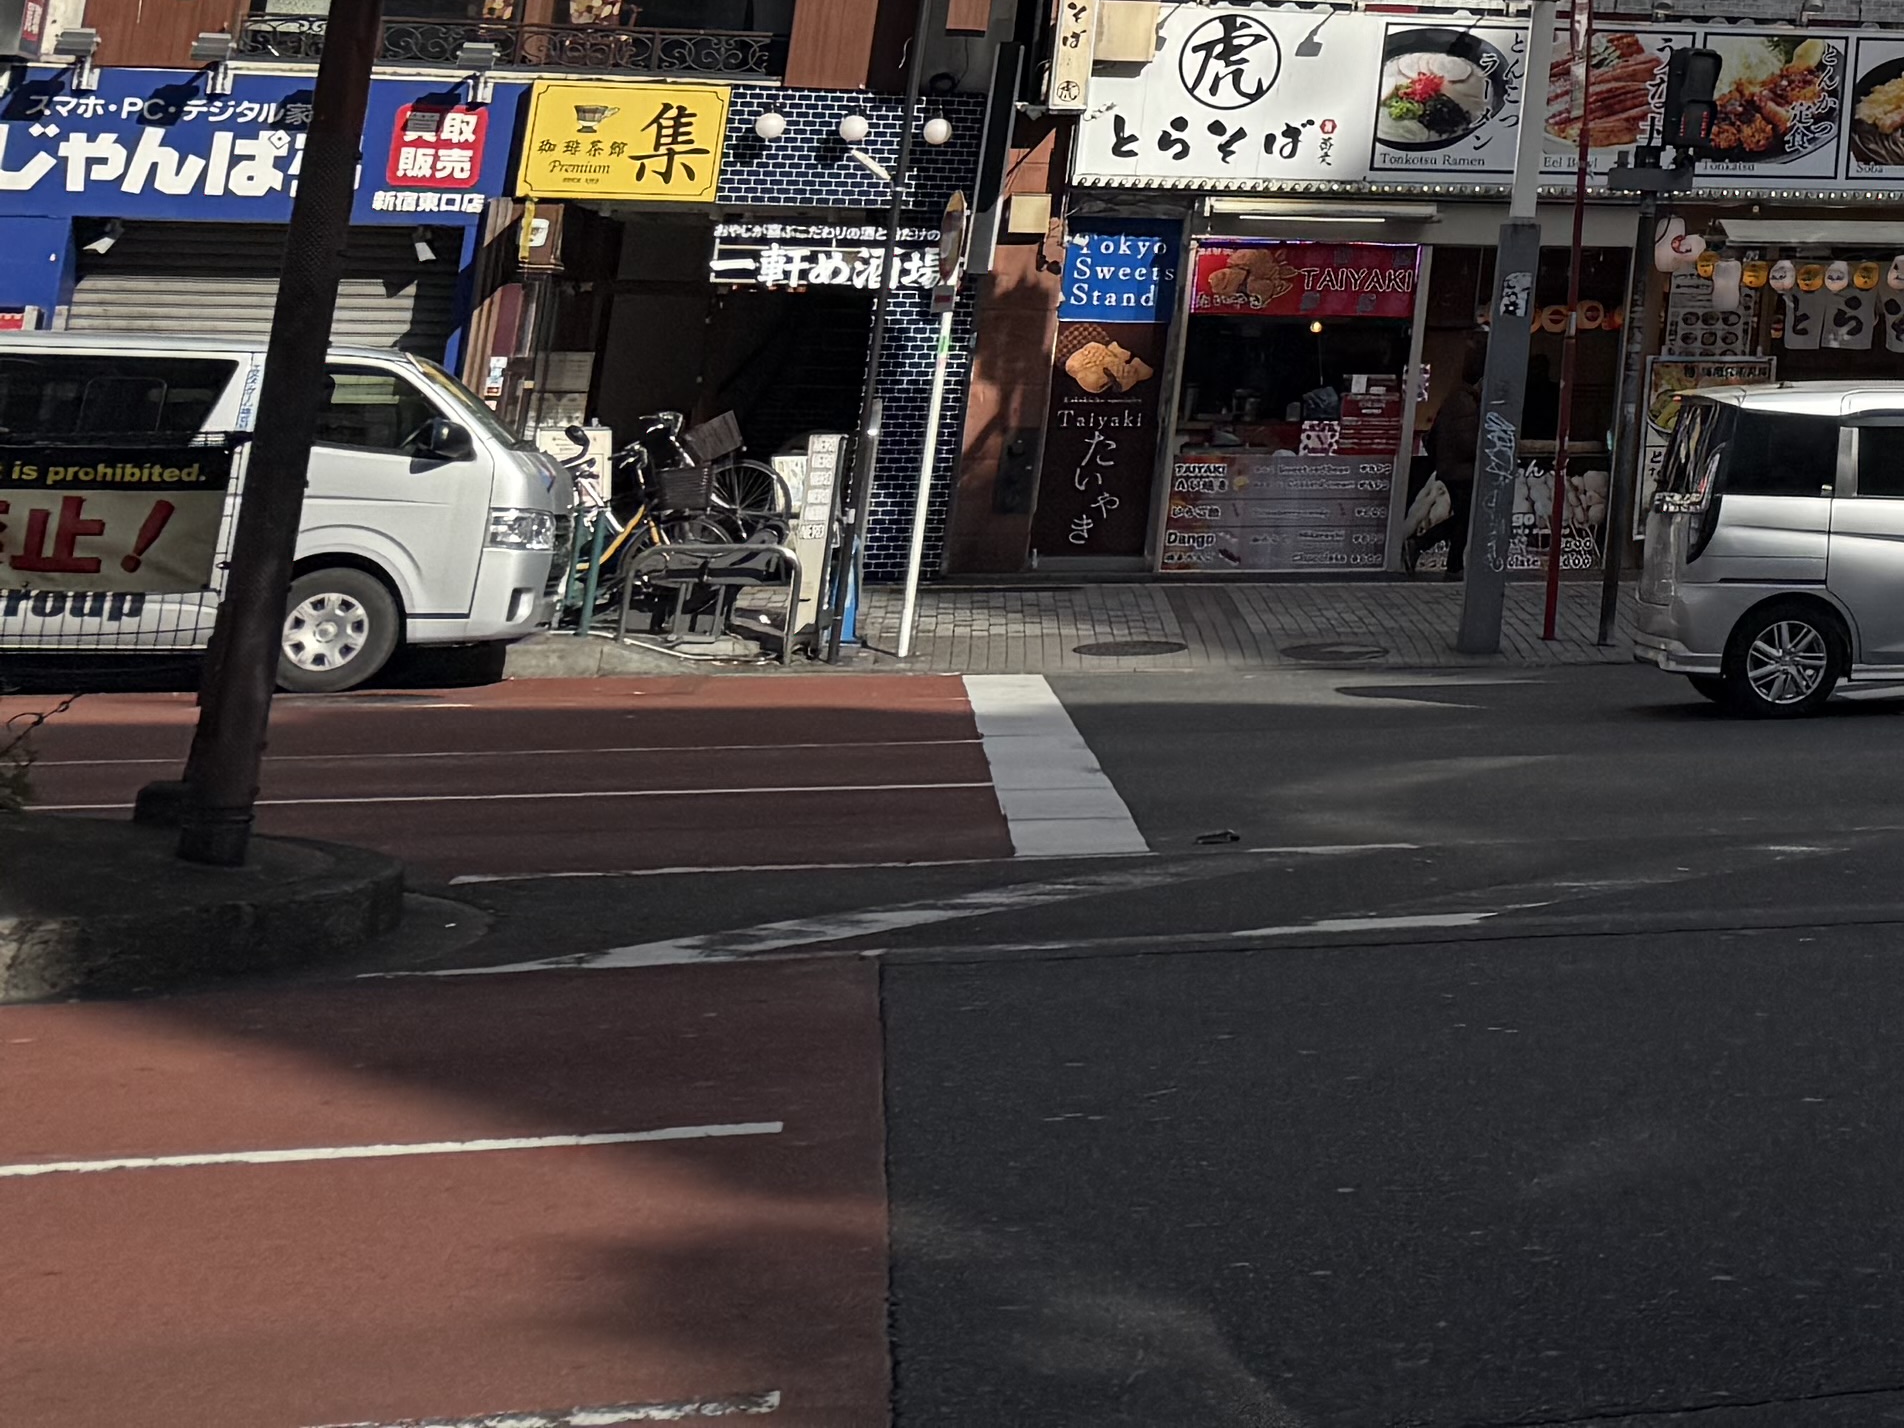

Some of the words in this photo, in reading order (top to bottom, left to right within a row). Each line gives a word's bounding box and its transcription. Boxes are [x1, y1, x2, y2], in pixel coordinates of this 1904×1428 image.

[1190, 14, 1269, 99] 虎
[1501, 31, 1525, 129] とんこつ
[1813, 43, 1838, 137] とんかつ
[1472, 50, 1499, 152] ラーメン
[402, 110, 478, 144] 買取
[1110, 112, 1317, 165] とらそば
[1784, 100, 1811, 152] 定食
[537, 138, 629, 159] 珈琲茶館
[627, 102, 711, 185] 集
[395, 147, 475, 180] 販売
[547, 159, 612, 177] Premium
[1379, 152, 1438, 168] Tonkotsu
[1441, 153, 1487, 169] Ramen
[1855, 161, 1885, 175] Soba
[372, 190, 486, 214] 新宿東口店
[1072, 256, 1175, 282] Sweets
[1299, 266, 1415, 294] TAIYAKI
[1069, 283, 1156, 308] Stand
[1056, 408, 1144, 430] Taiyaki
[11, 461, 39, 482] is
[46, 462, 208, 486] prohibited.
[1067, 431, 1121, 546] たいやき
